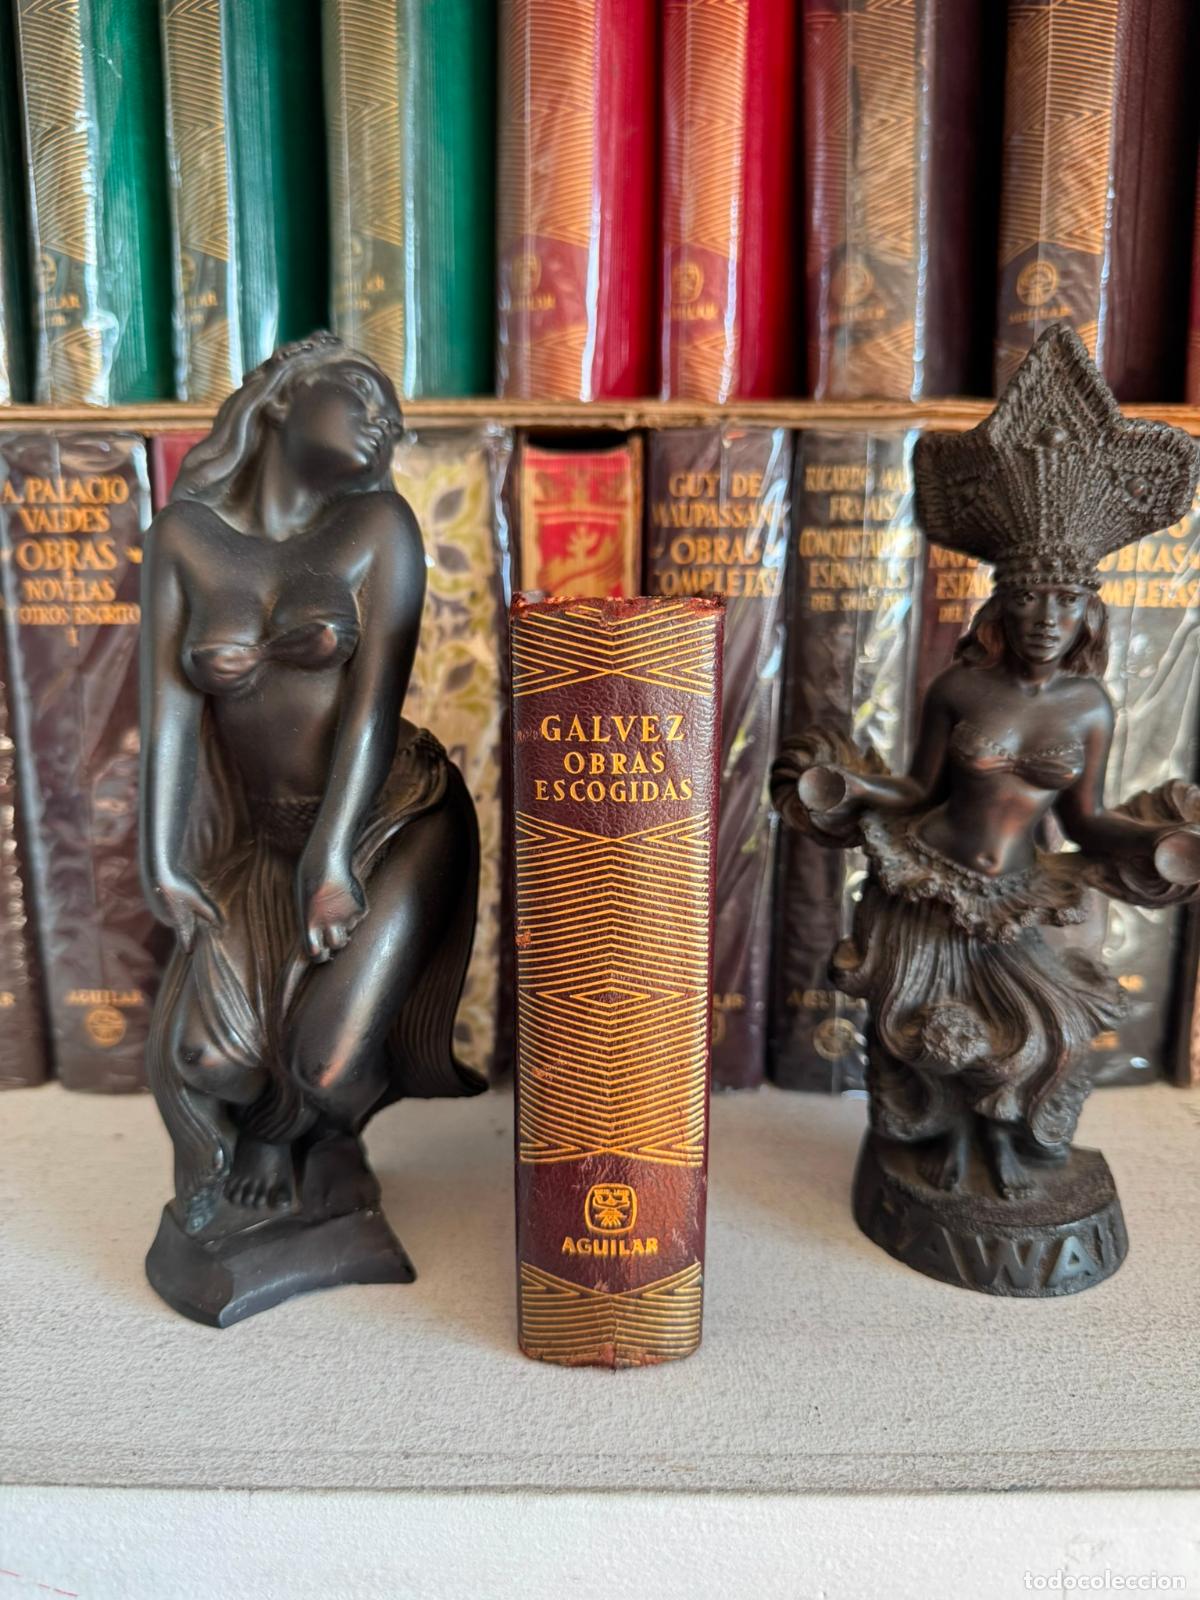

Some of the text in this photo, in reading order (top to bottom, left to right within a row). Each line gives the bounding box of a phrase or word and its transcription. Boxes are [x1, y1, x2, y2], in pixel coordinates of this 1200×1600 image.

[26, 475, 129, 504] PALACIO
[668, 470, 763, 498] GUY DE
[16, 539, 118, 571] OBRAS
[670, 534, 761, 565] OBRAS
[23, 579, 116, 602] NOVELAS
[1097, 577, 1200, 608] MPLETAS
[19, 604, 70, 625] OTROS
[73, 603, 141, 625] ESCRITO
[540, 714, 686, 742] GALVEZ
[563, 751, 666, 775] OBRAS
[535, 778, 693, 802] ESCOGIDAS
[562, 1236, 660, 1257] AGUILAR
